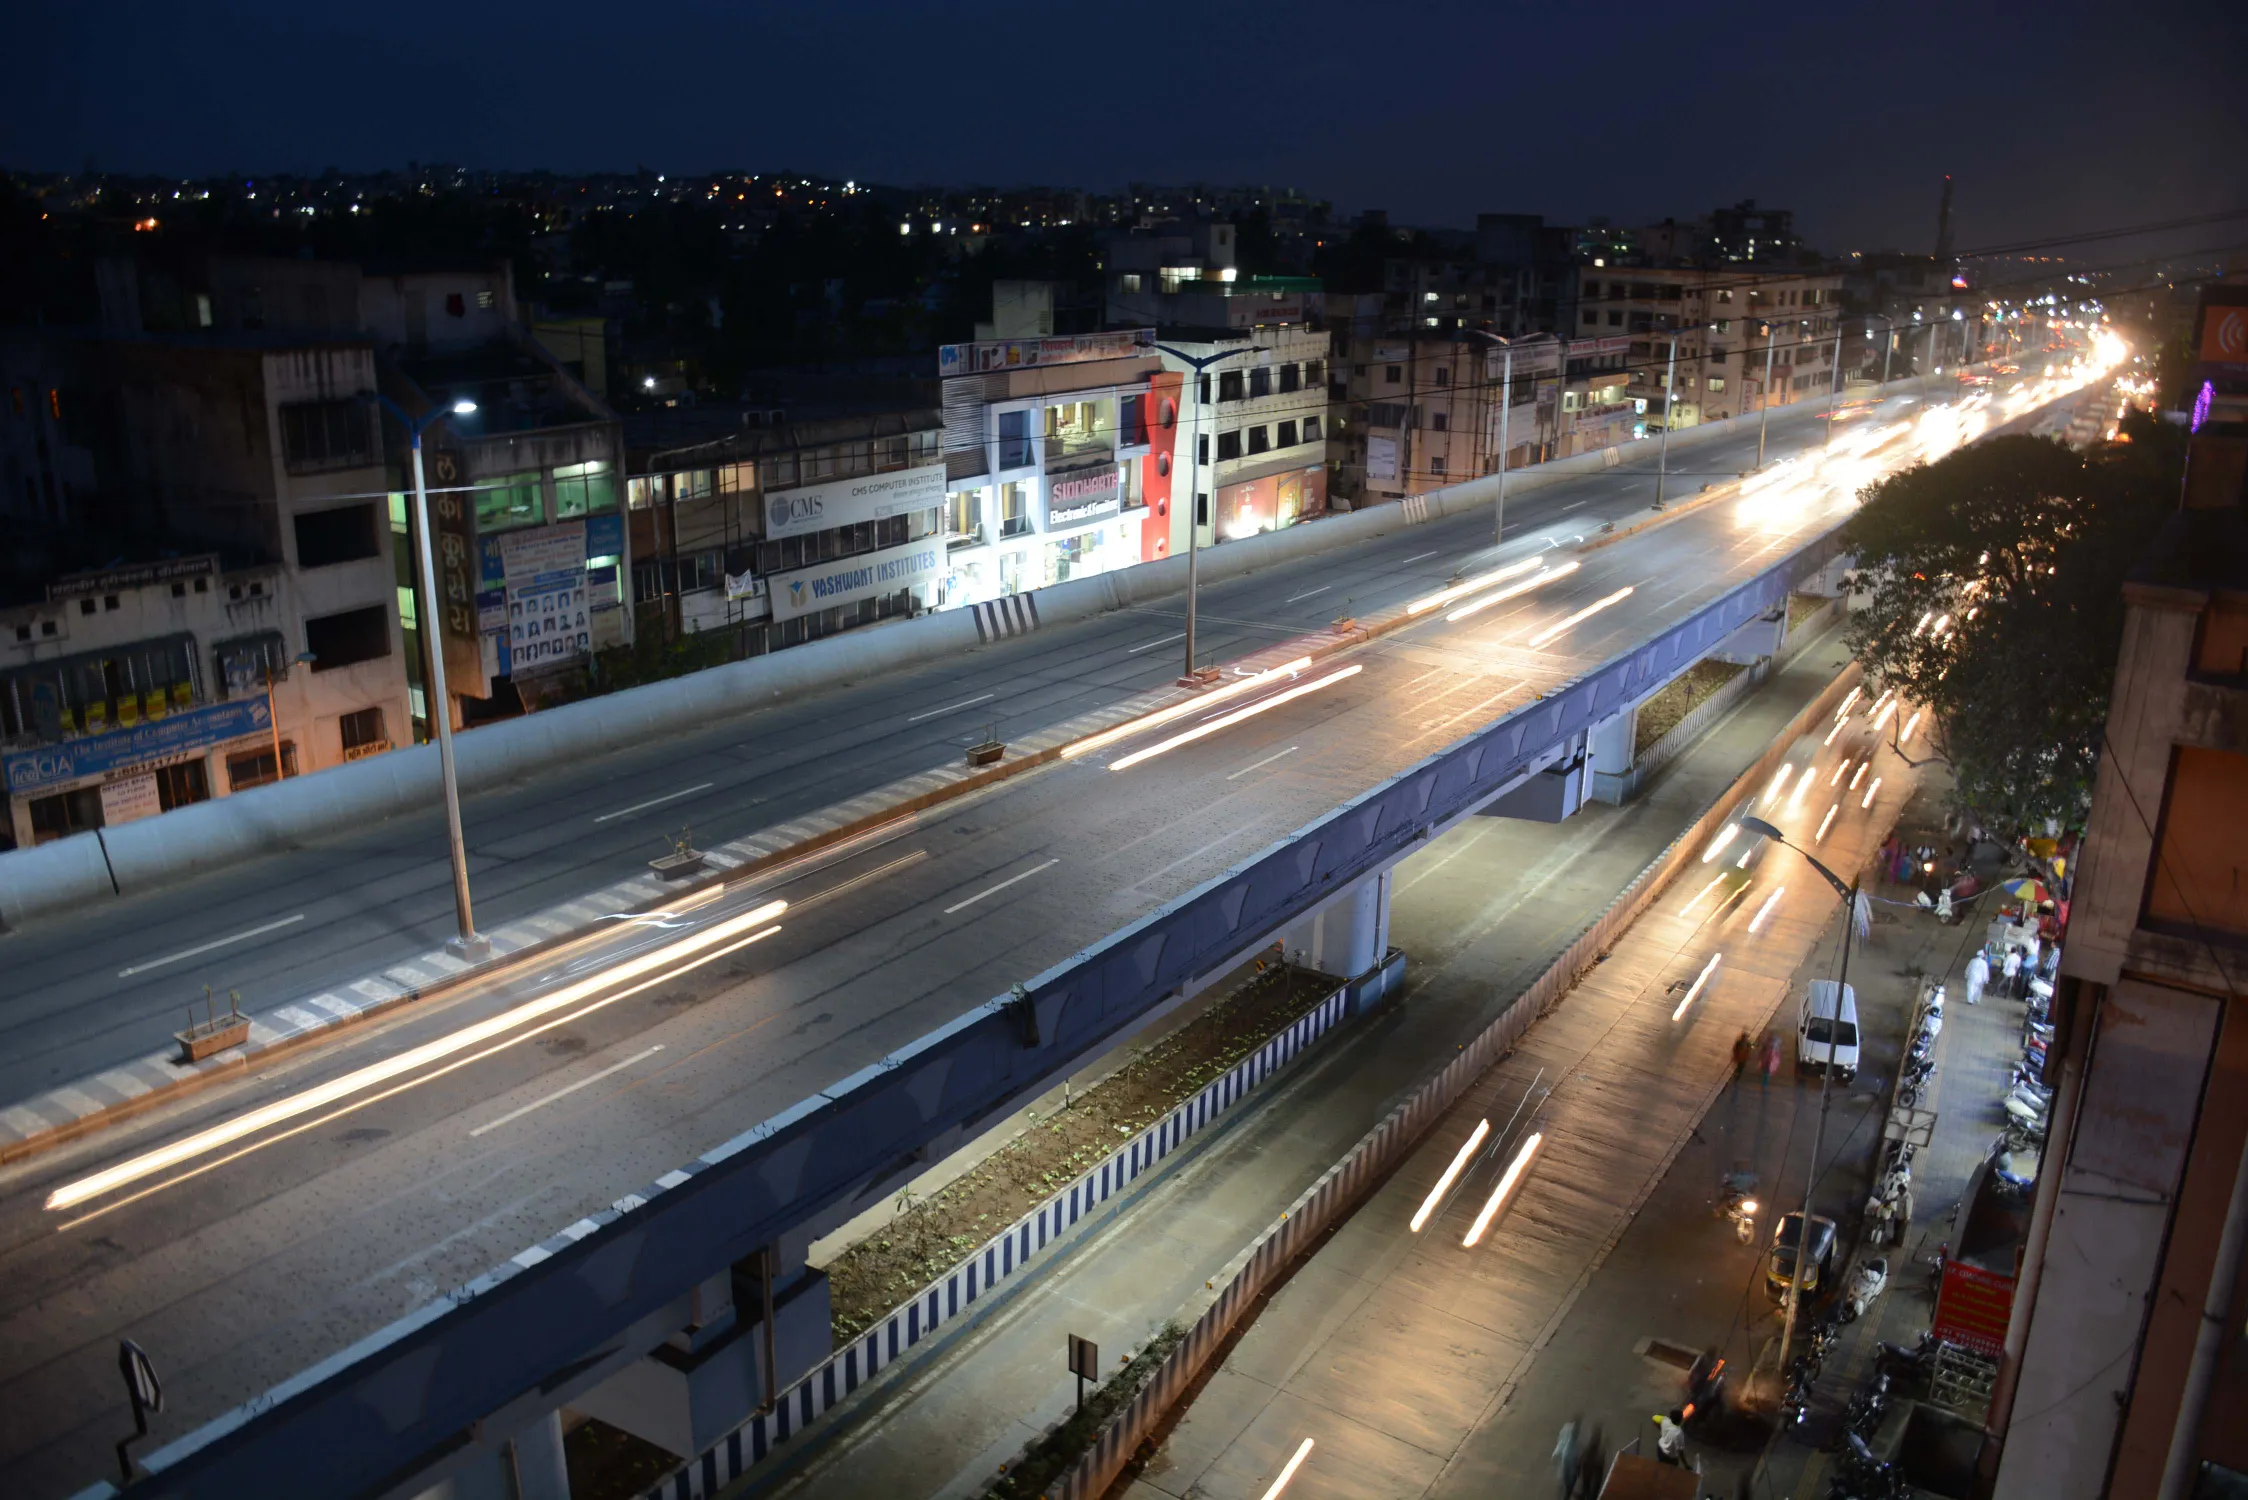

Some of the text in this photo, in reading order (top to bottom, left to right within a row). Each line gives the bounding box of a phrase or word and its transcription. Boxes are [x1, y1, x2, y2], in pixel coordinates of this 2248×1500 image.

[852, 486, 868, 498] CMS
[869, 479, 908, 495] COMPUTER
[908, 471, 944, 487] INSTITUTE
[1052, 472, 1118, 503] SIDDHARTH
[790, 495, 824, 519] CMS
[812, 550, 937, 599] YASHWANT INSTITUTES
[73, 743, 90, 757] The
[94, 735, 131, 754] Institute
[133, 731, 144, 744] of
[145, 722, 188, 741] Computer
